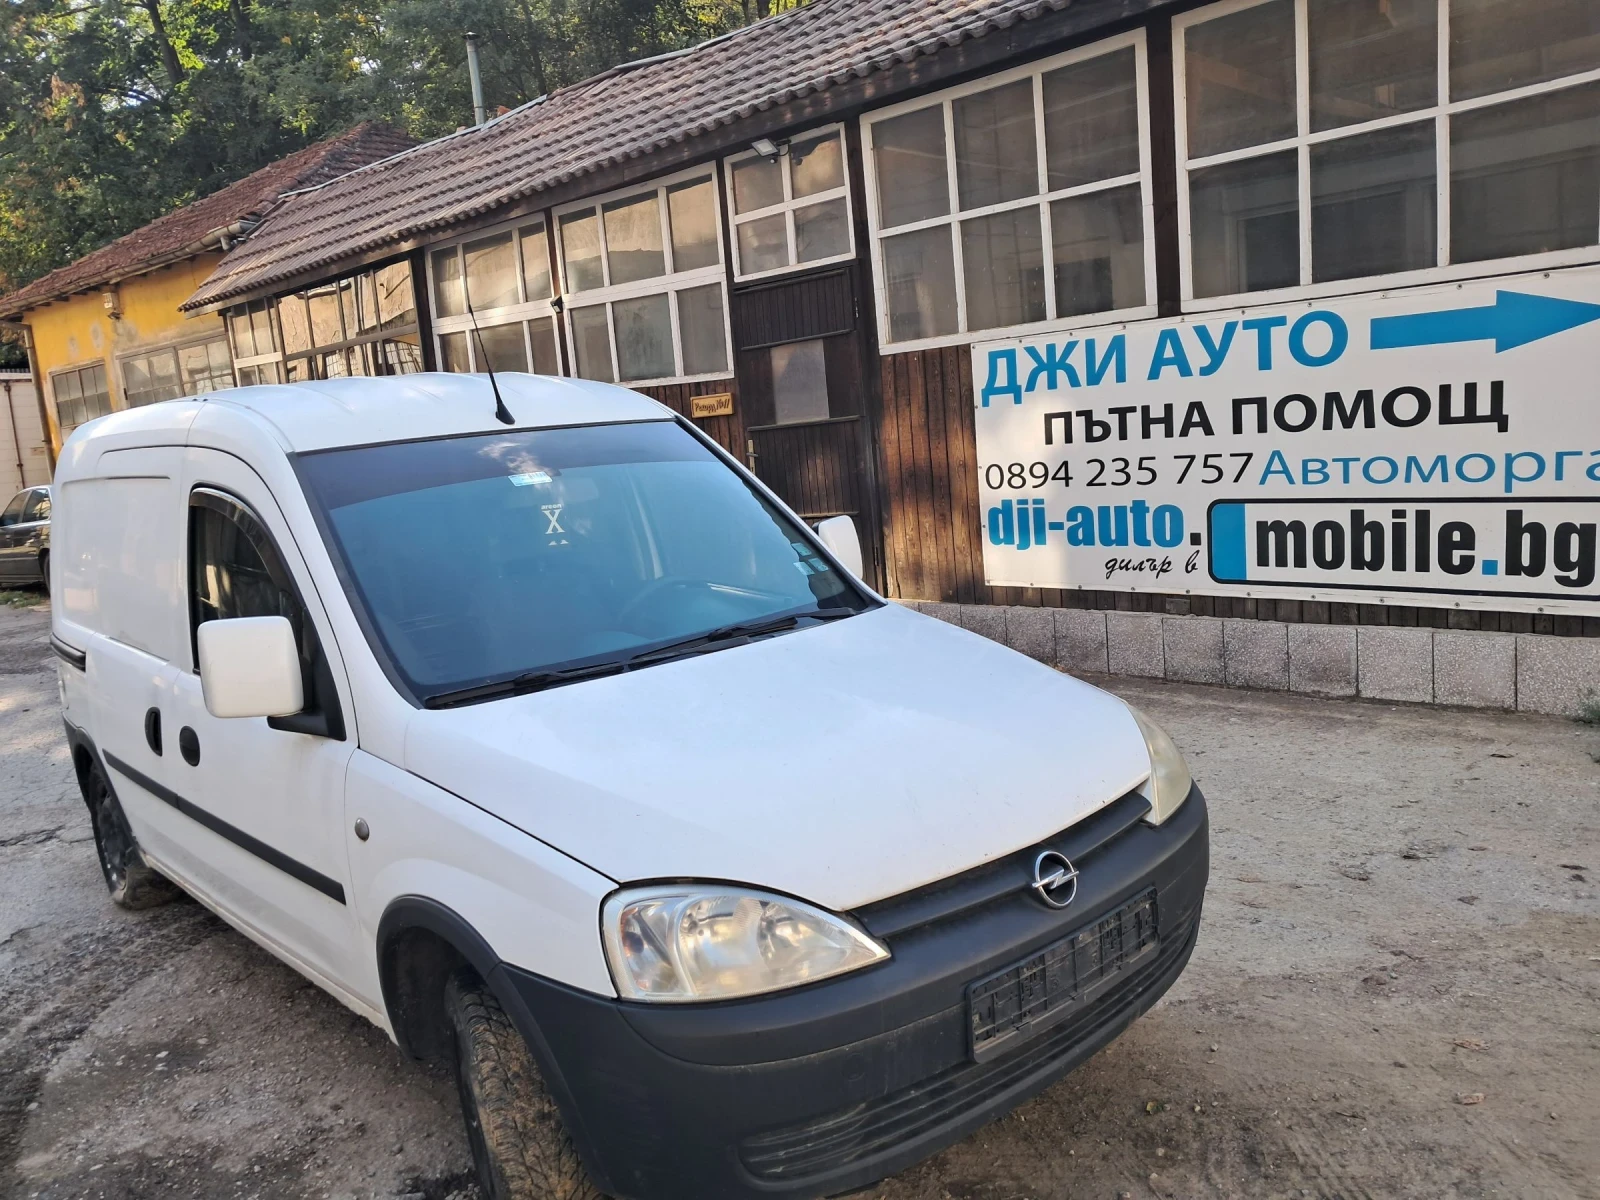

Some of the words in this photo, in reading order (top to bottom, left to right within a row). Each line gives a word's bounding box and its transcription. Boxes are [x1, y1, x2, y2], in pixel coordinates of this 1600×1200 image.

[981, 333, 1127, 408] ДЖИ
[1147, 310, 1349, 381] АУТО
[1043, 400, 1215, 446] ПЪТНА
[1231, 380, 1510, 435] ПОМОЩ
[984, 458, 1074, 490] 0894
[1085, 456, 1158, 488] 235
[1173, 452, 1254, 485] 757
[987, 497, 1202, 551] dji-auto.
[1256, 508, 1597, 588] mobile.bg
[1104, 553, 1173, 580] дилър
